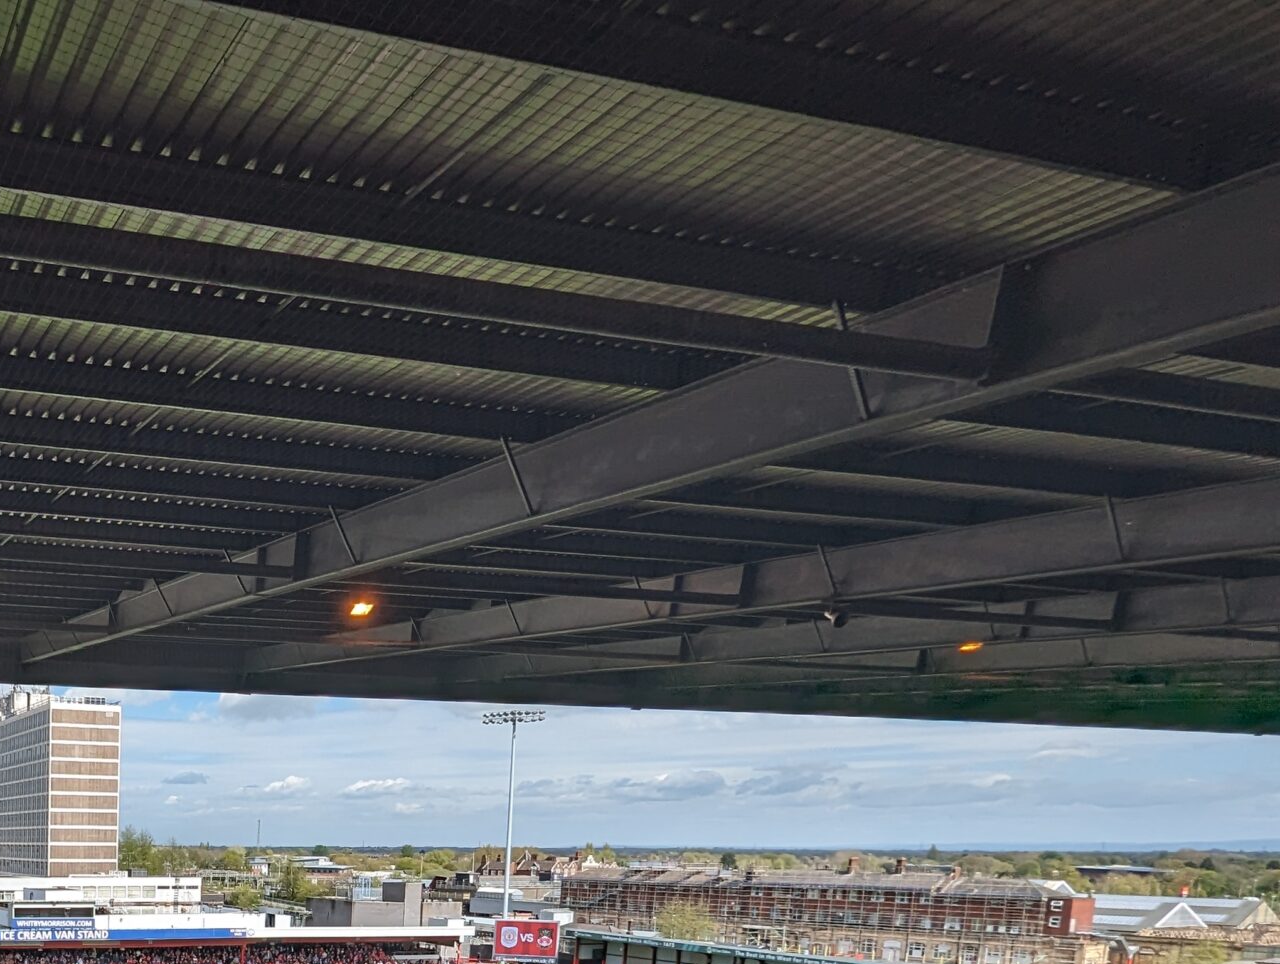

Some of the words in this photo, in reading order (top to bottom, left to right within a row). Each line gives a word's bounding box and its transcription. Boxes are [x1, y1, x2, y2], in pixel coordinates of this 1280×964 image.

[16, 920, 93, 928] WHITBYMORRISON.COM
[0, 930, 15, 940] ICE
[17, 930, 52, 940] CREAM
[53, 930, 74, 940] VAN
[77, 930, 109, 940] STAND
[520, 933, 534, 943] VS
[735, 949, 745, 957] The
[745, 951, 757, 959] Best
[777, 955, 792, 963] West
